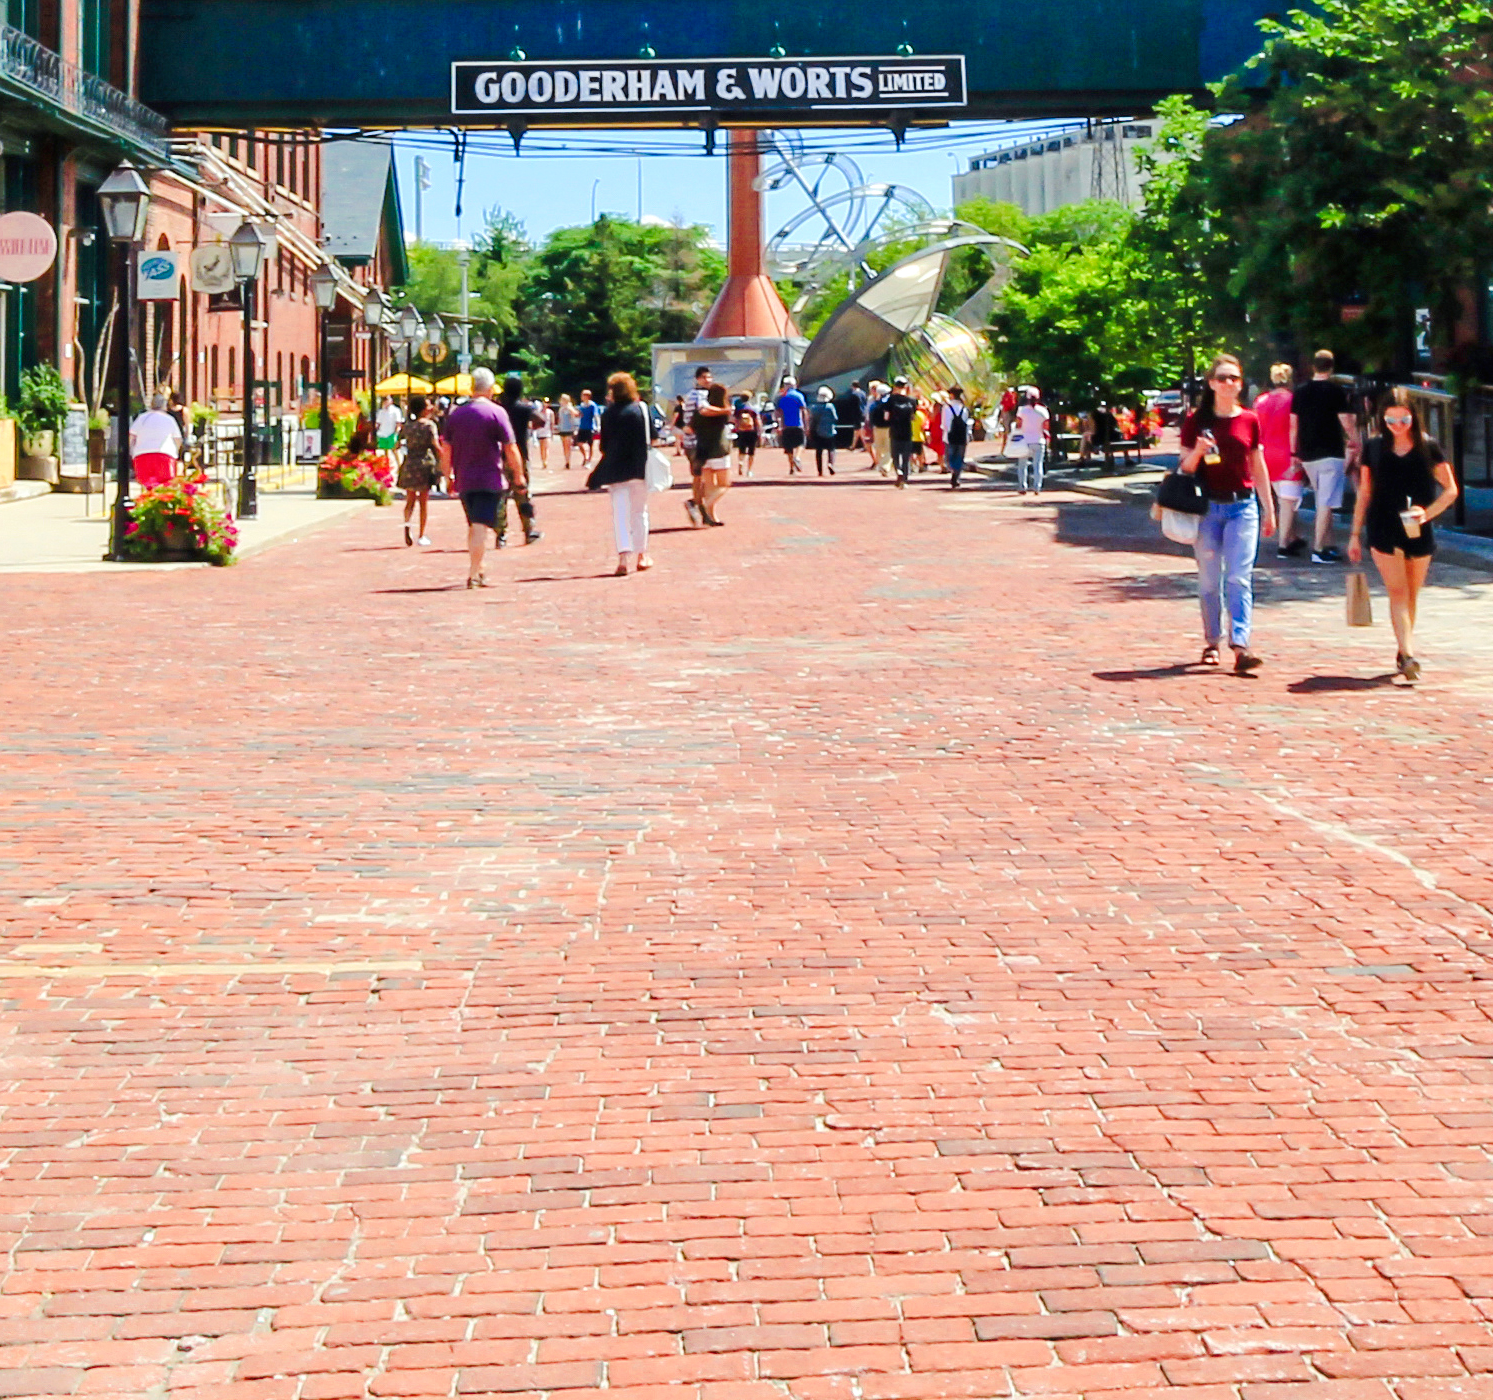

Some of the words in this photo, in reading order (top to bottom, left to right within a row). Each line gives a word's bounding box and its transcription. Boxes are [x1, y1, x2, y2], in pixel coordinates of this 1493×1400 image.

[475, 69, 705, 103] GOODERHAM
[715, 68, 746, 100] &
[748, 67, 874, 99] WORTS
[879, 72, 948, 91] LIMITED
